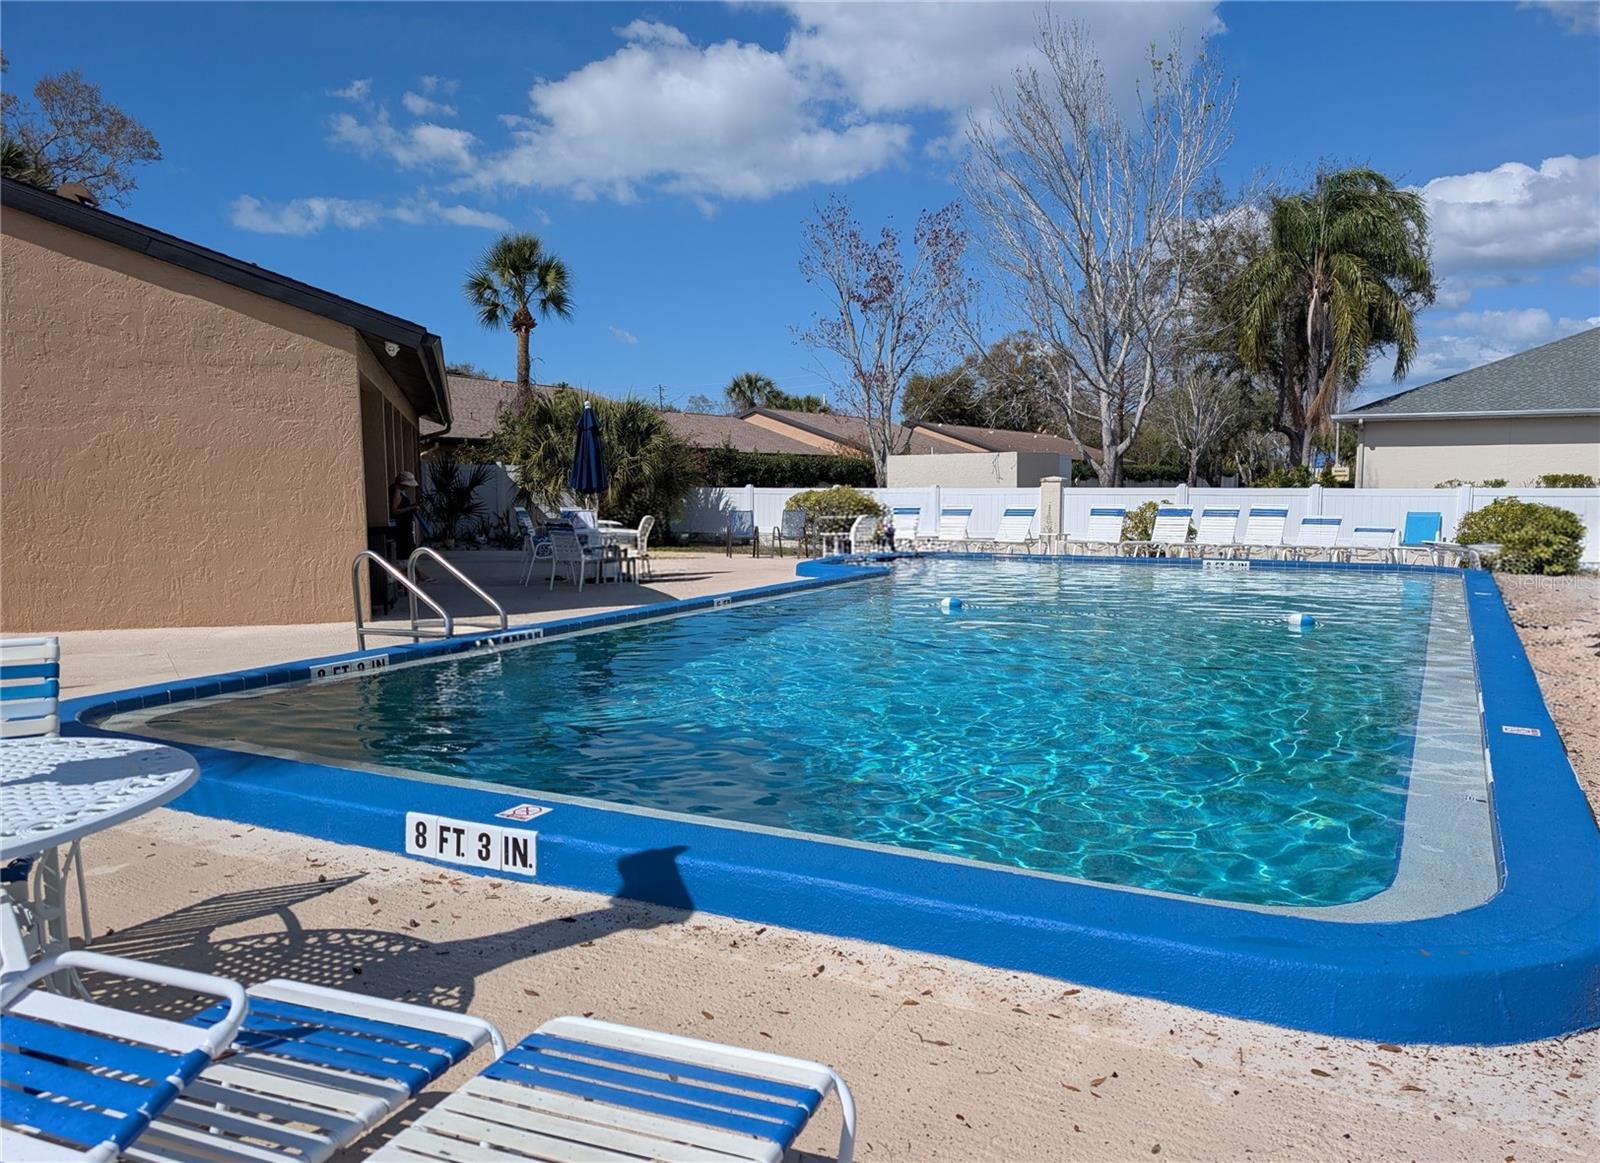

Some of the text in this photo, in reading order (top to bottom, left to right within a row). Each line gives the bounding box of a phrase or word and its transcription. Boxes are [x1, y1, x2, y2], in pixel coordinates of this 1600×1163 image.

[415, 821, 533, 868] 8 FT. 3 IN.
